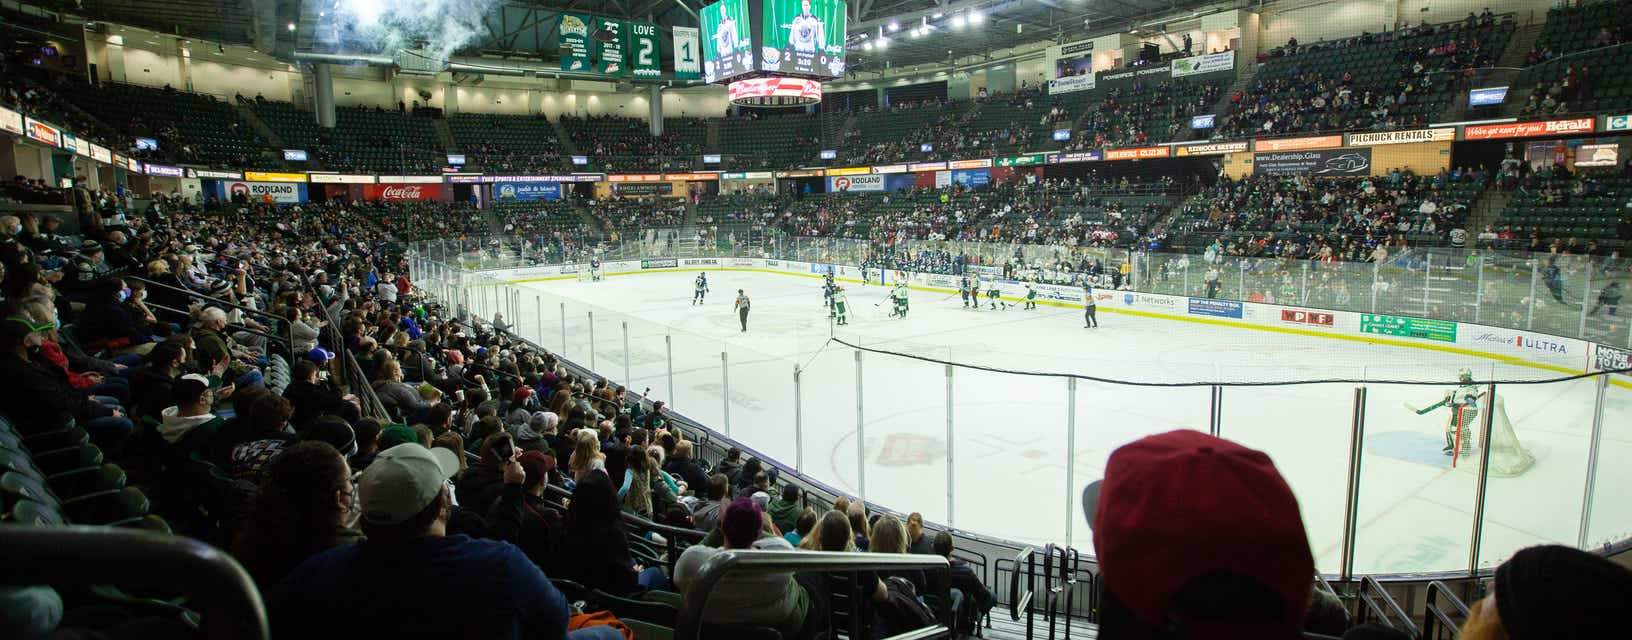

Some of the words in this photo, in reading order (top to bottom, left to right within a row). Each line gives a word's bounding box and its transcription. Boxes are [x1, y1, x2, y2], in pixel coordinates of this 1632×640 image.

[633, 25, 655, 36] LOVE
[639, 38, 654, 65] 2
[682, 42, 694, 63] 1
[784, 52, 791, 61] 2
[820, 56, 827, 64] 0
[1546, 118, 1591, 132] Herald
[1351, 132, 1392, 143] PILCHUCK
[1395, 130, 1433, 141] RENTALS
[852, 176, 881, 184] RODLAND
[252, 185, 292, 194] RODLAND
[1526, 338, 1568, 354] ULTRA
[1598, 345, 1628, 362] MORE
